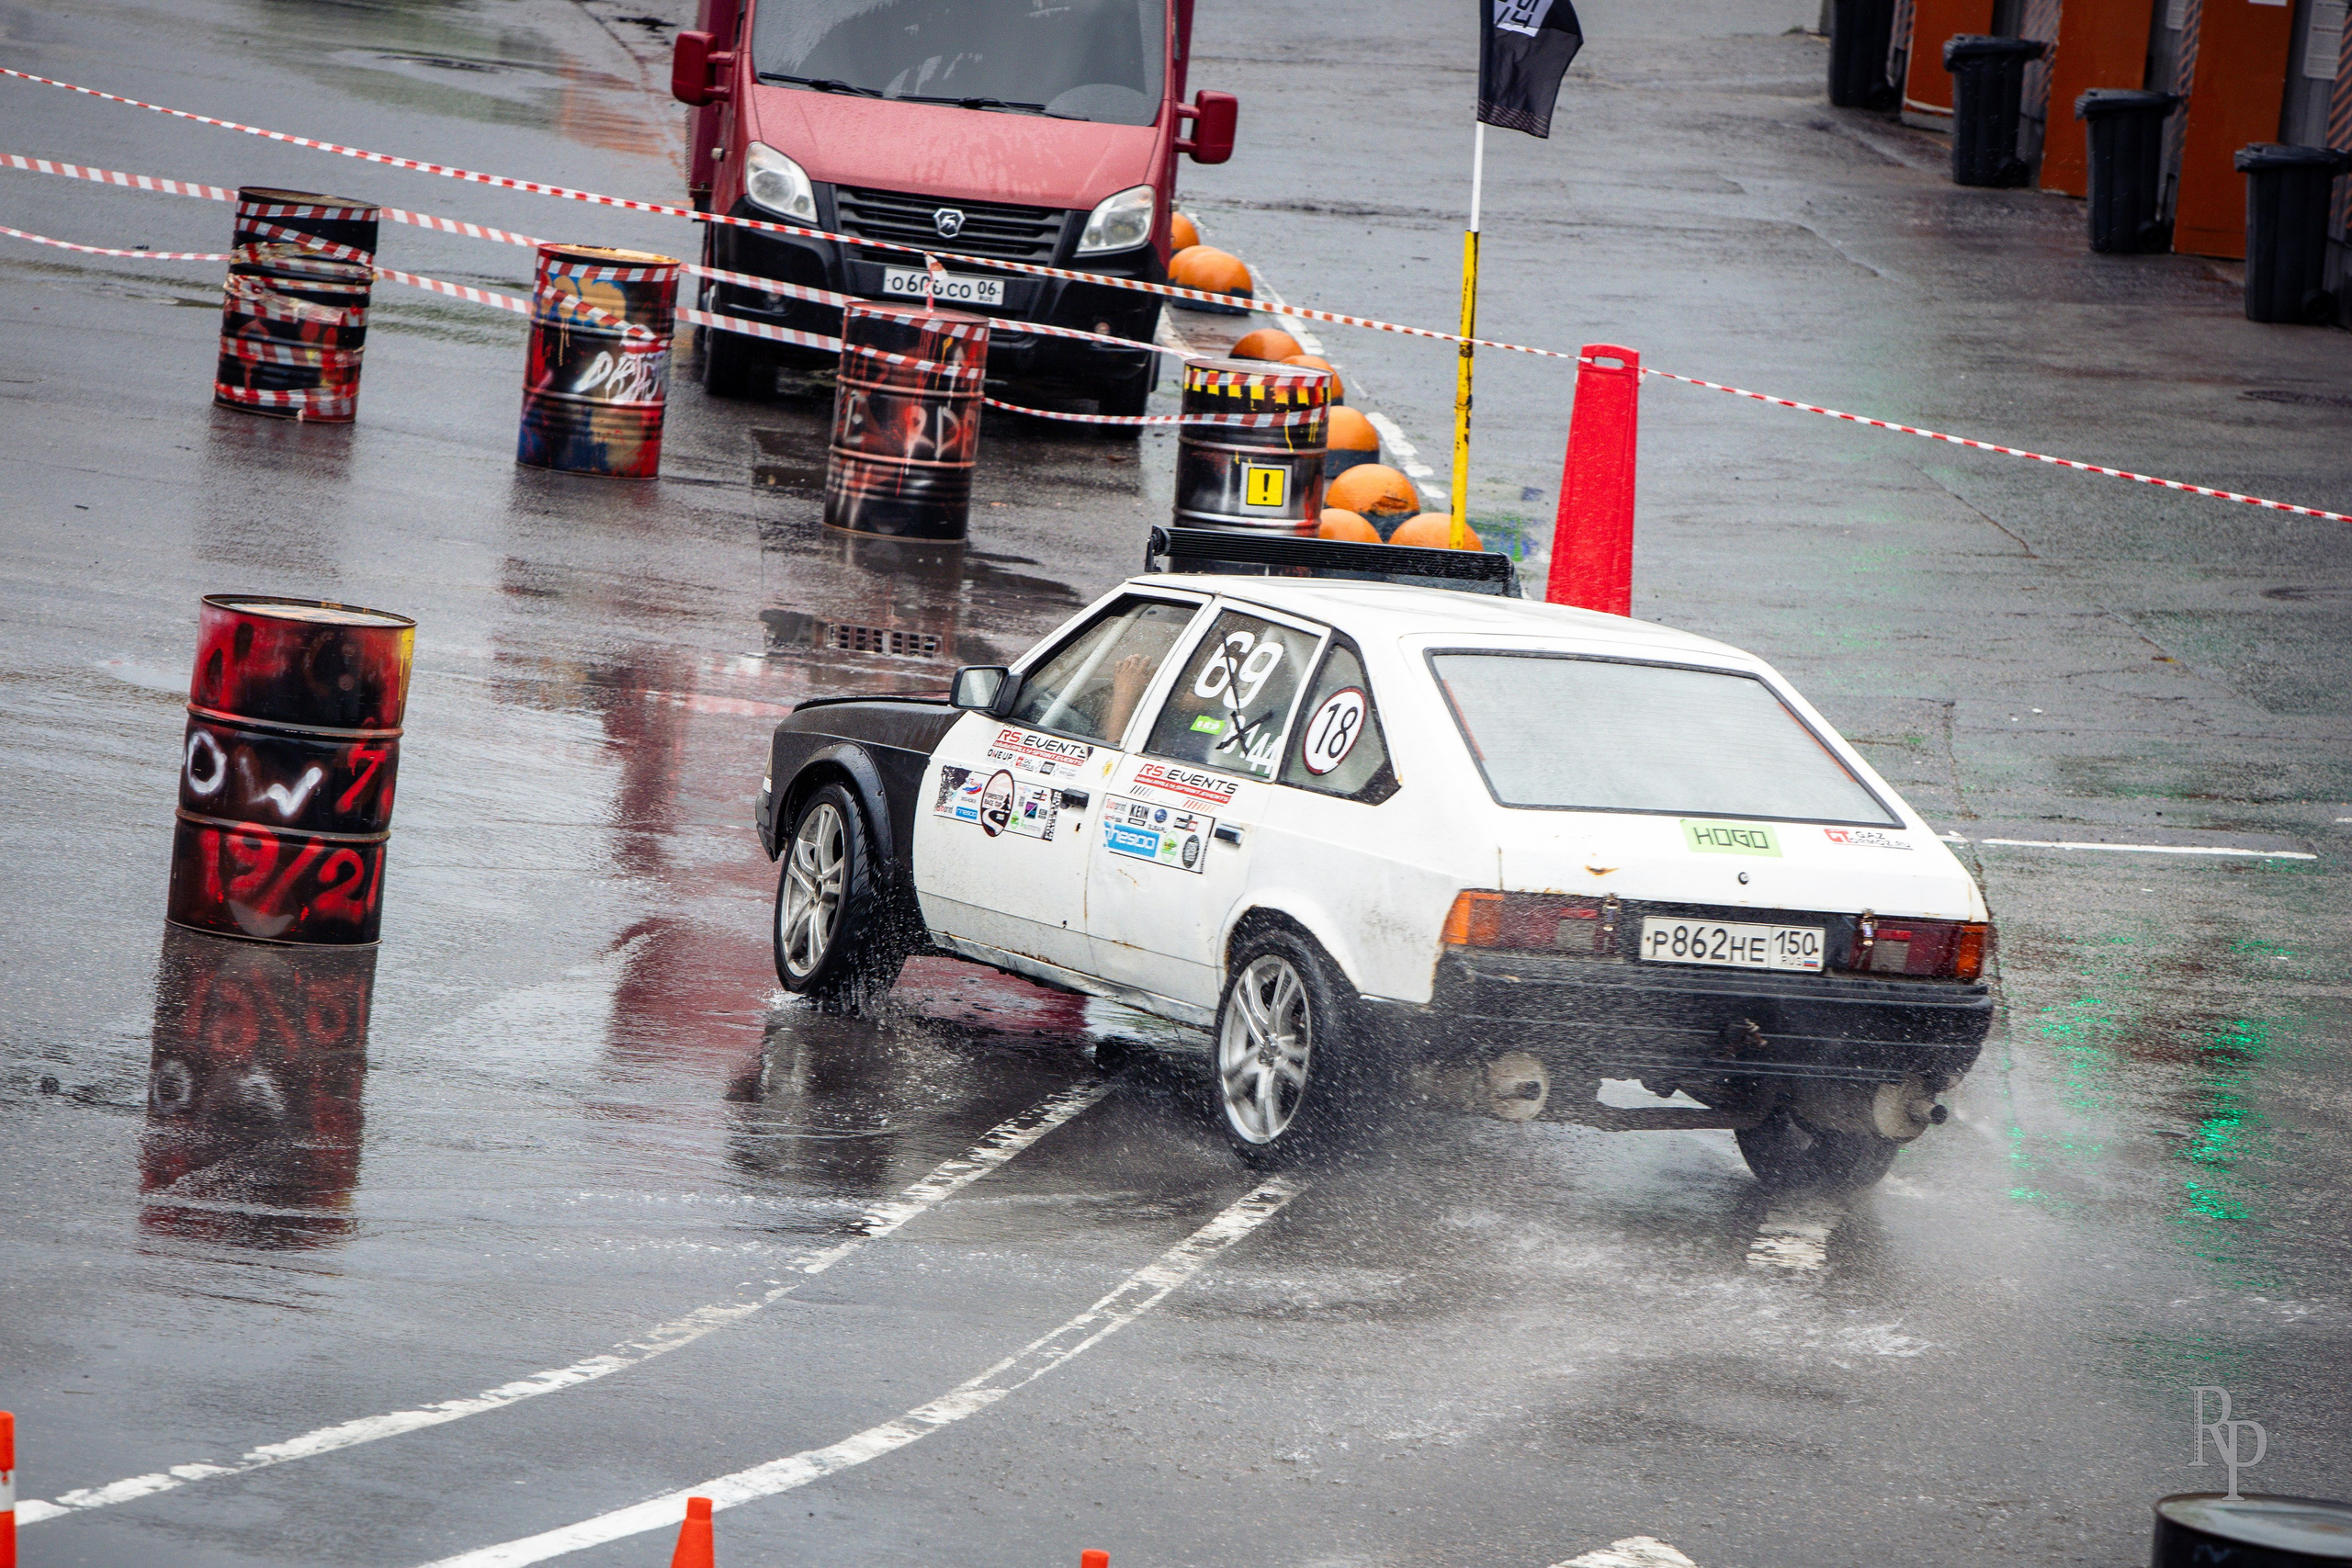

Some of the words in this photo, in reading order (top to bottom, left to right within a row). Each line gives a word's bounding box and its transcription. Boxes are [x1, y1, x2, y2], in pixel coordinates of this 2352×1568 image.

[978, 281, 996, 296] 06
[1194, 631, 1284, 709] 69
[1315, 703, 1359, 759] 18
[1773, 930, 1815, 956] 150
[1781, 955, 1803, 966] RUS
